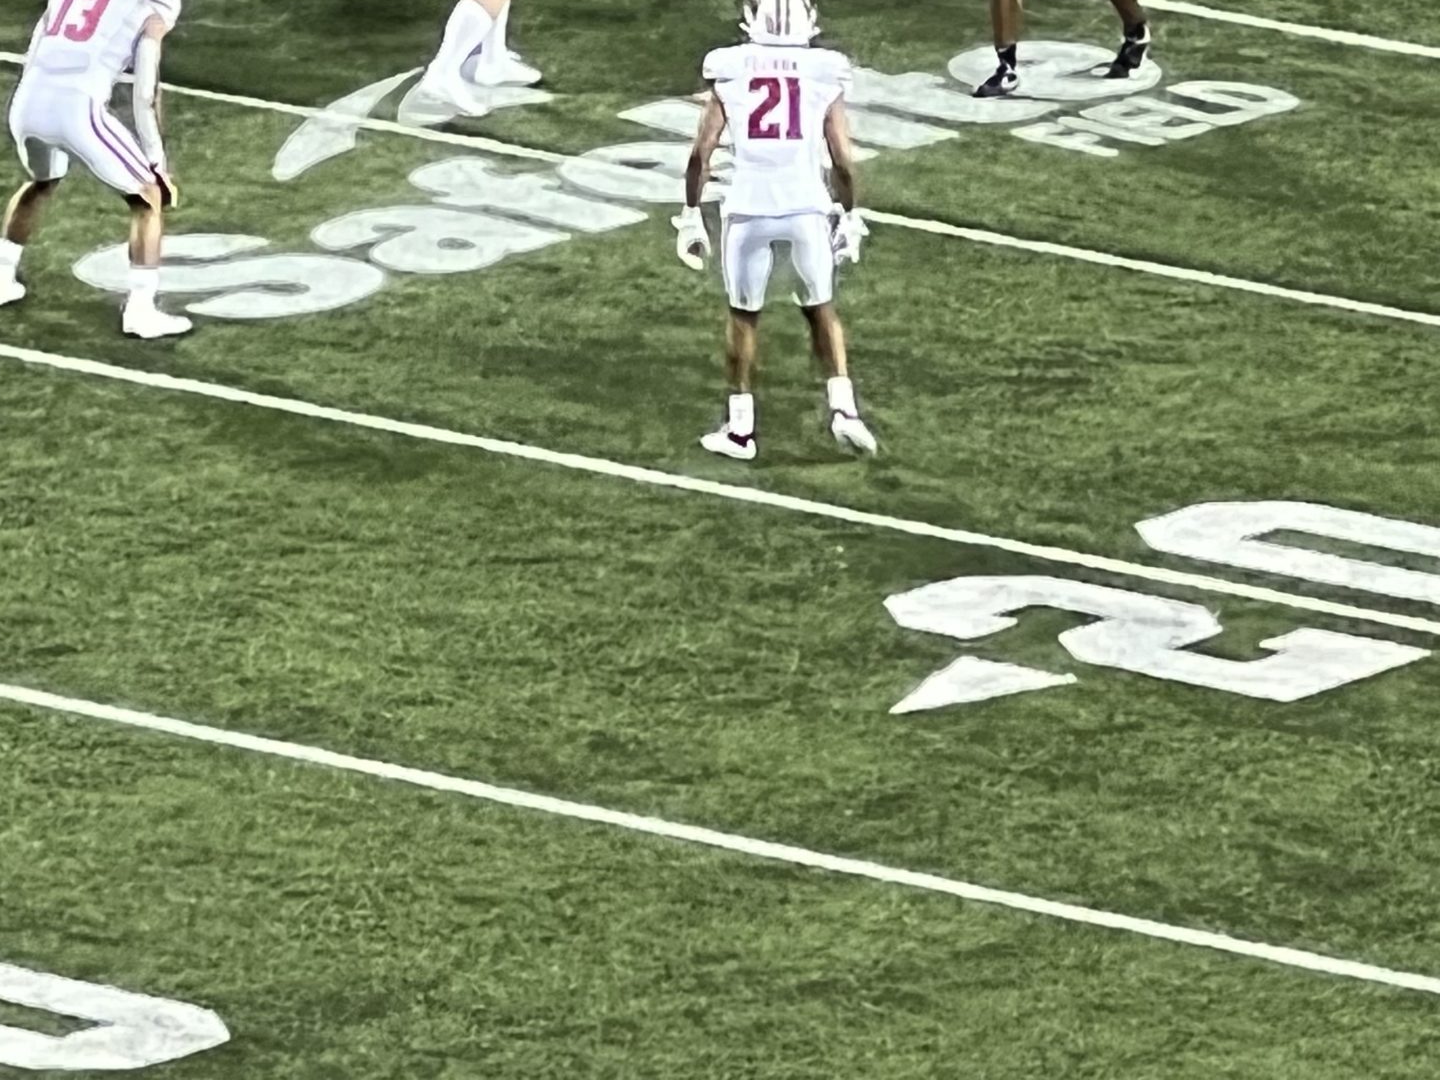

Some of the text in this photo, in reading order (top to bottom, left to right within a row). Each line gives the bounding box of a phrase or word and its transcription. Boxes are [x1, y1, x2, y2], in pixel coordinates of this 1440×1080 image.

[747, 77, 804, 140] 21
[1010, 79, 1301, 158] FIELD
[72, 40, 1163, 319] Safete
